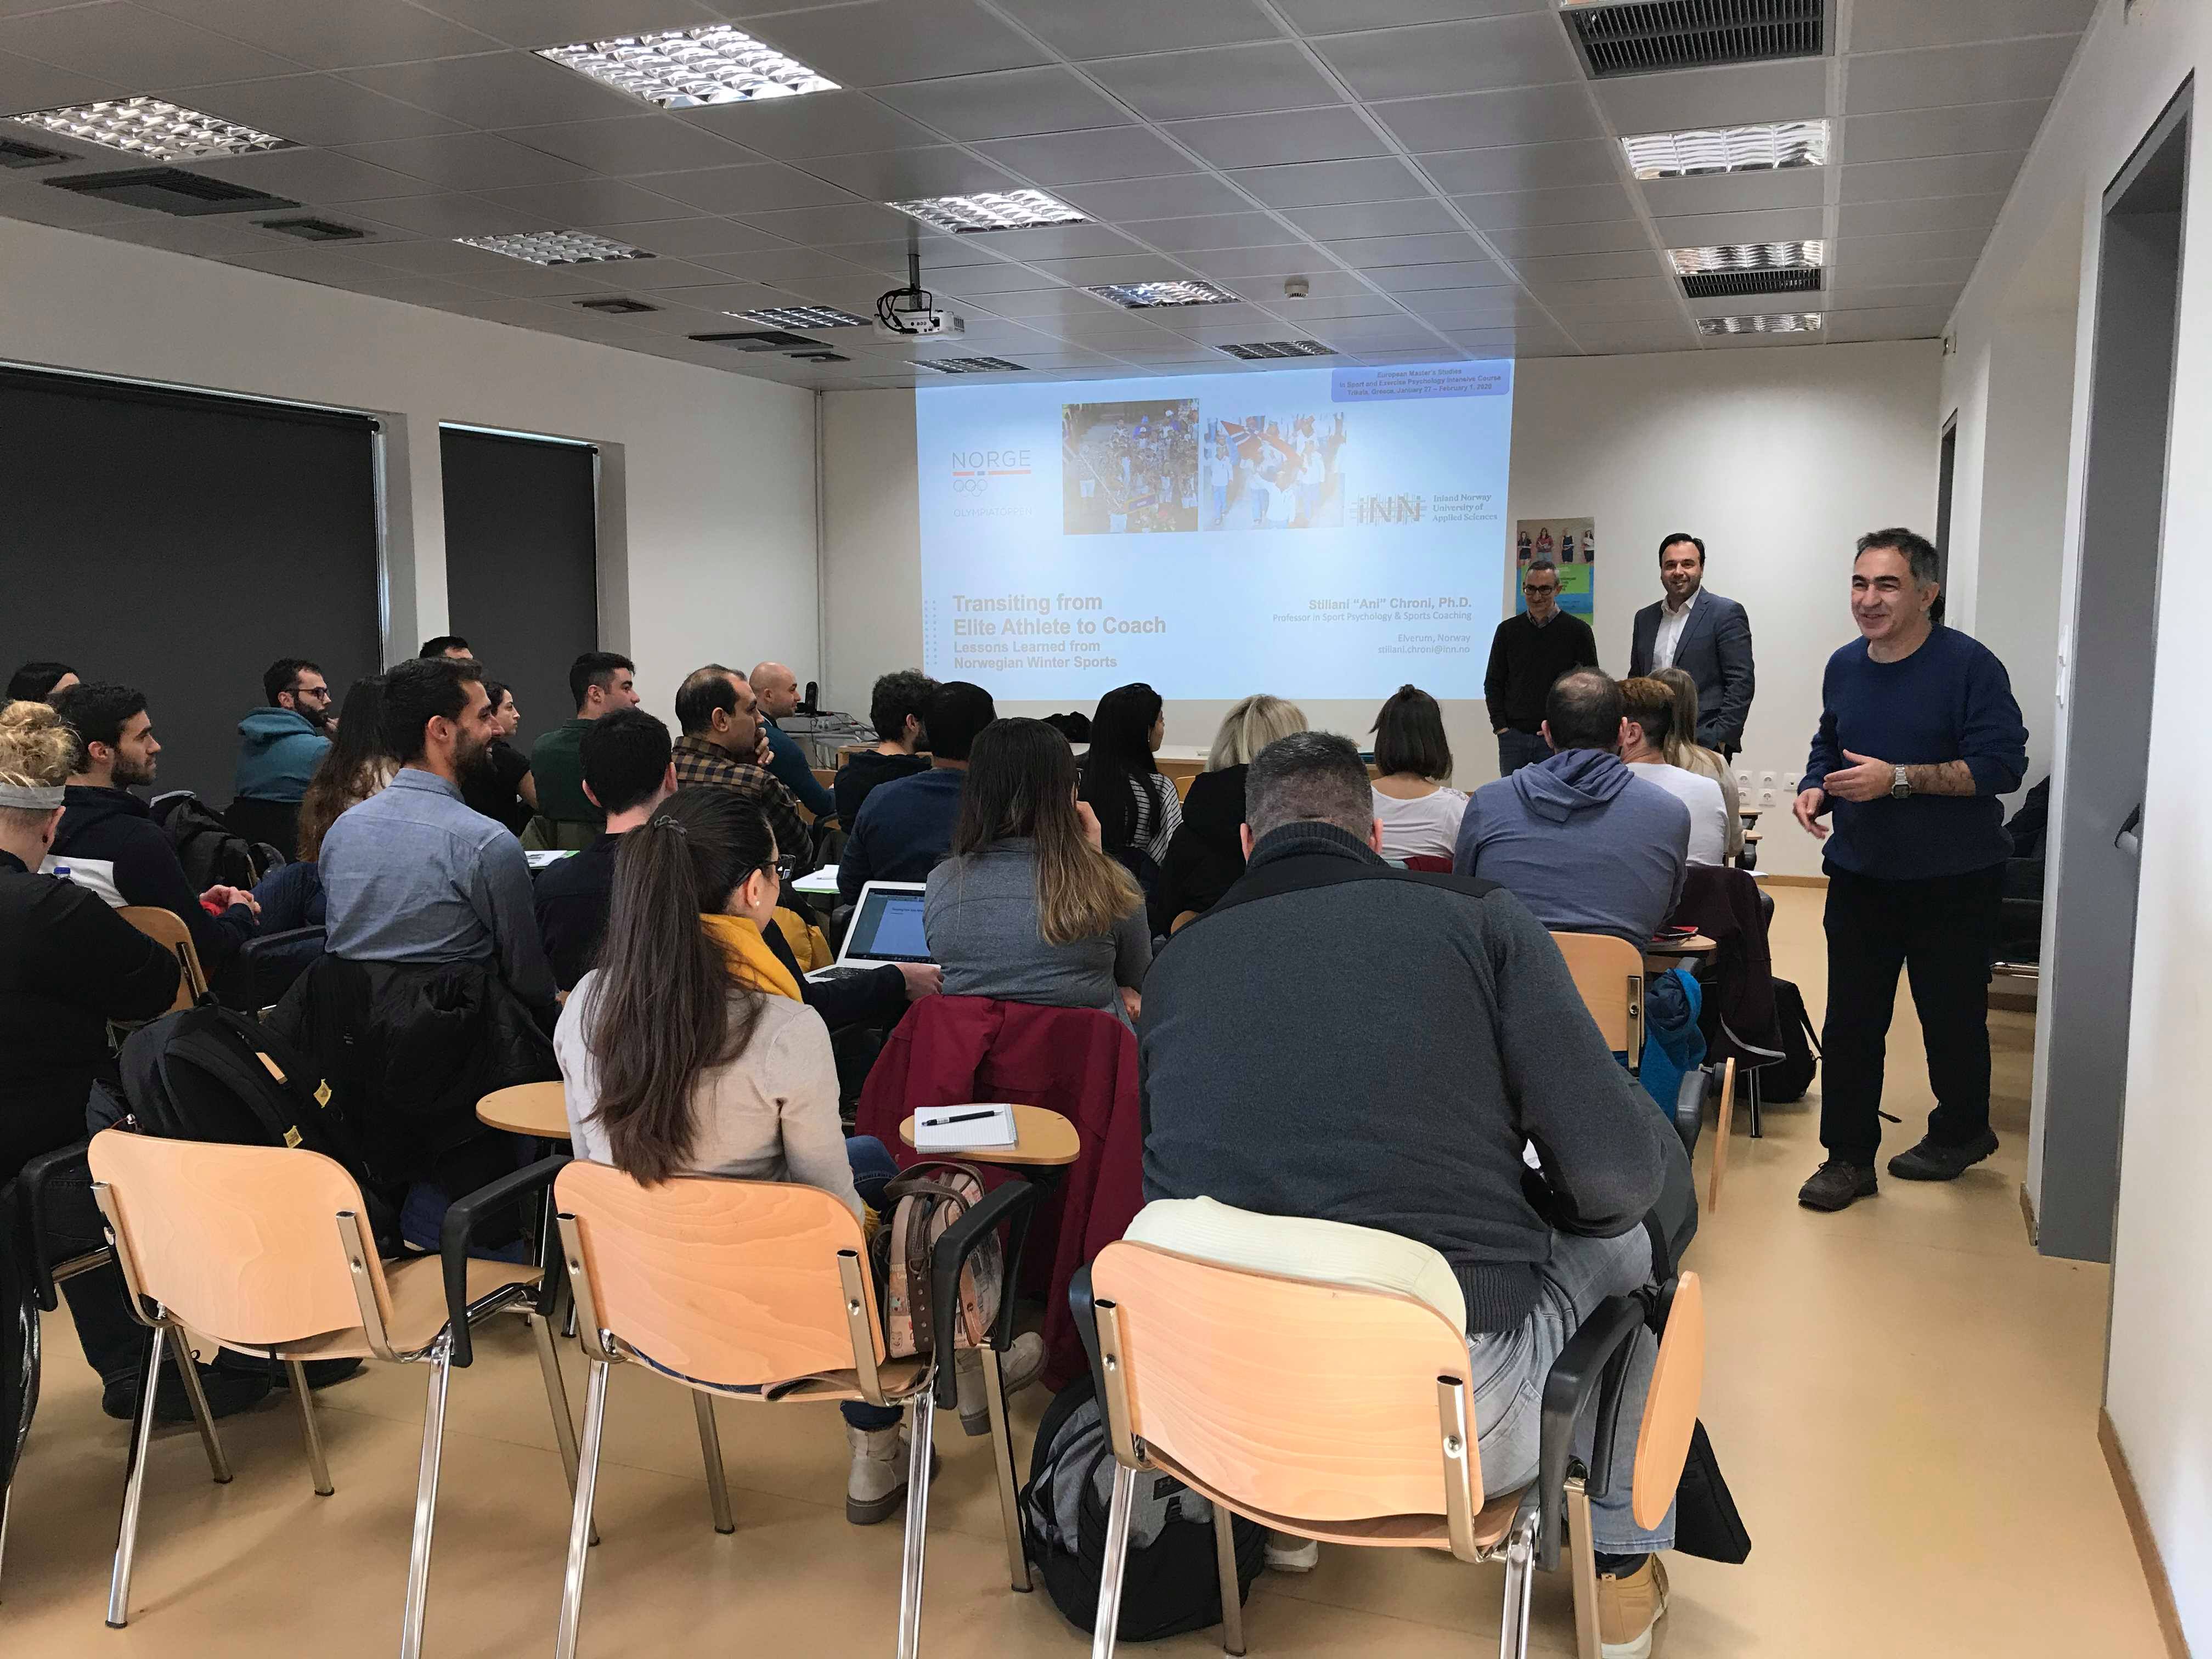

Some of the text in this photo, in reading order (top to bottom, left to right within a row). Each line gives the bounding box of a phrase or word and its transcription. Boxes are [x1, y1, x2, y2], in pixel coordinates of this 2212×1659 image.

[1408, 377, 1445, 385] Psychology
[952, 450, 1031, 469] NORGE
[1433, 504, 1473, 512] University
[1433, 514, 1462, 522] Applied
[952, 593, 1102, 615] Transiting from
[1390, 597, 1435, 609] Chroni,
[1438, 597, 1471, 607] Ph.D.
[1273, 613, 1310, 622] Professor
[1322, 613, 1344, 622] Sport
[1347, 612, 1392, 622] Psychology
[1403, 612, 1431, 621] Sports
[1432, 611, 1471, 621] Coaching
[954, 616, 1166, 635] Elite Athlete to Coach
[1398, 634, 1471, 643] Elverum, Norway
[954, 640, 1100, 653] Lessons Learned from
[955, 656, 1118, 671] Norwegian Winter Sports
